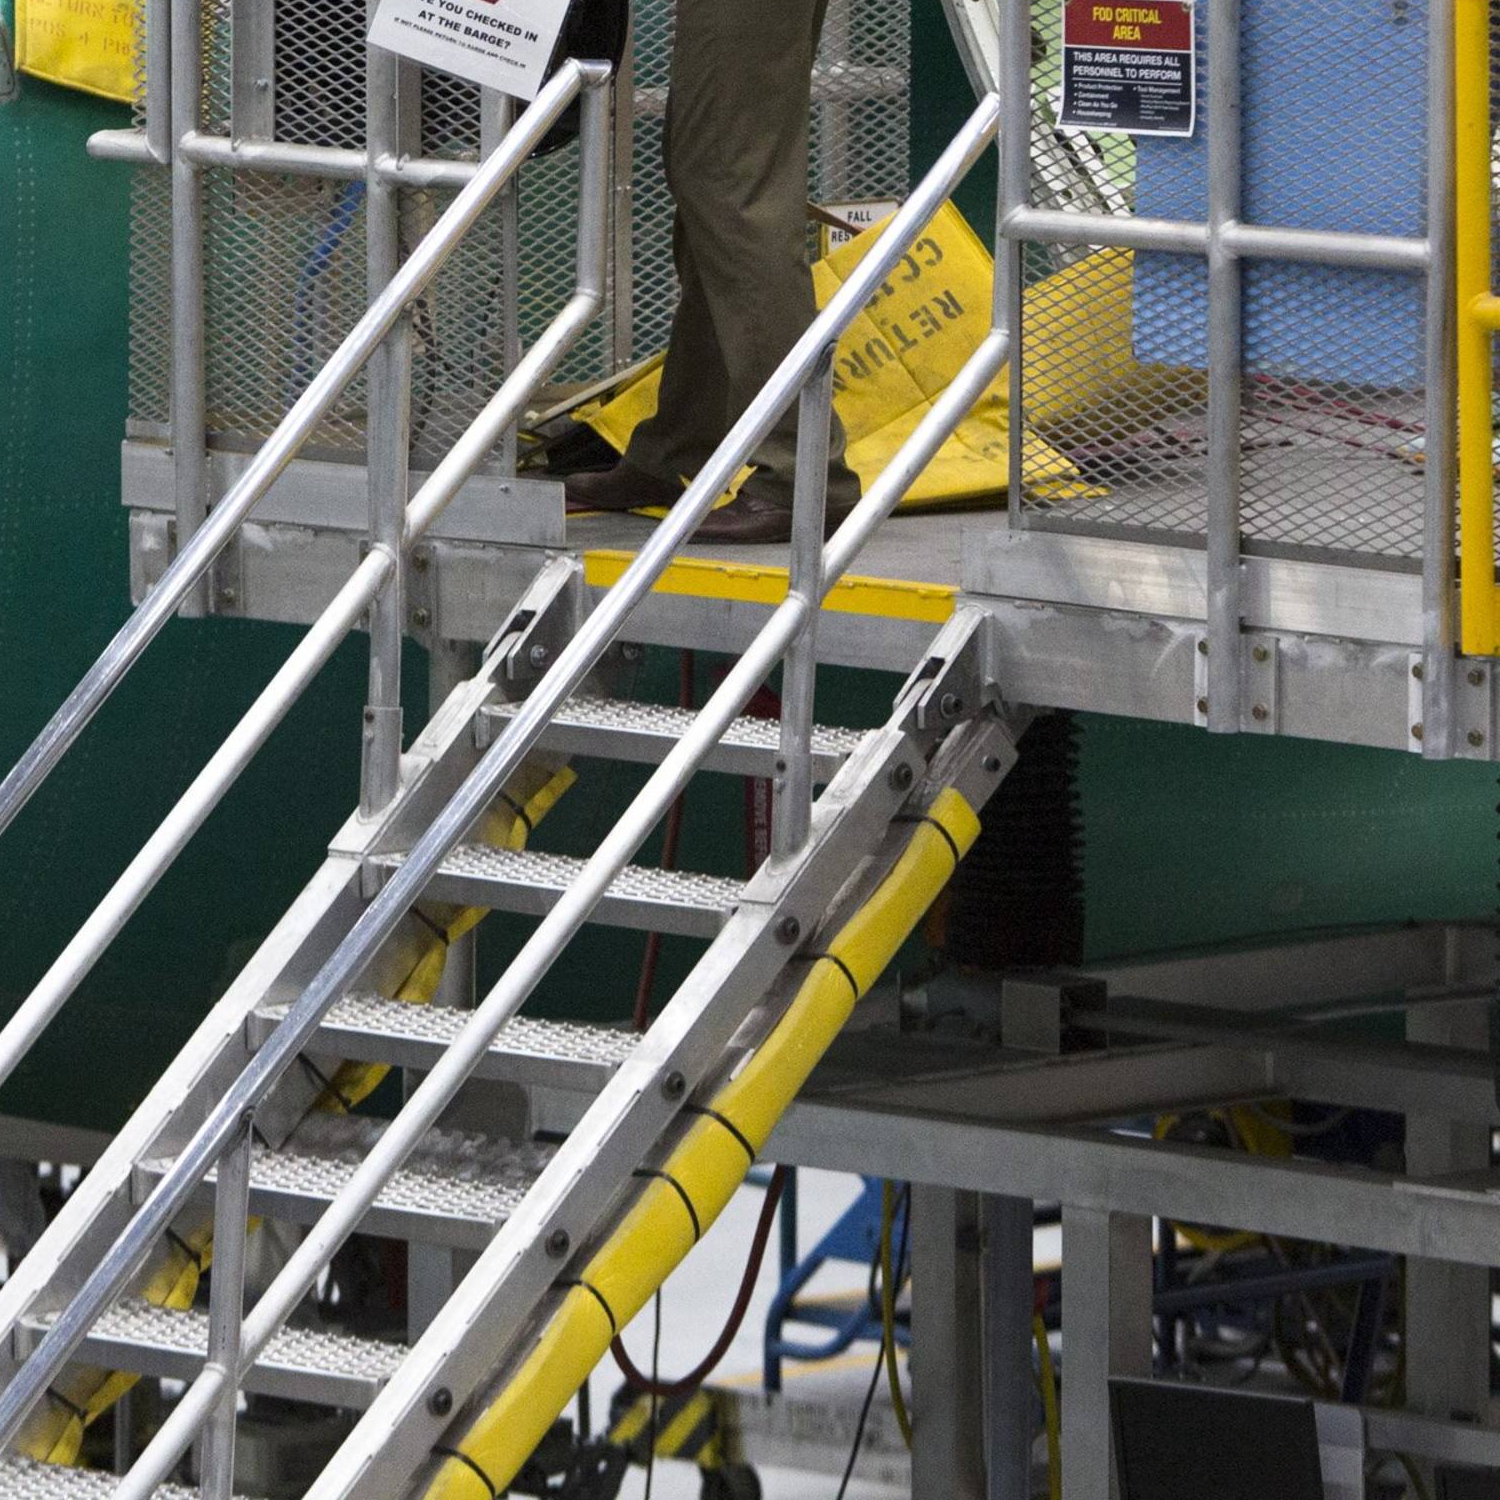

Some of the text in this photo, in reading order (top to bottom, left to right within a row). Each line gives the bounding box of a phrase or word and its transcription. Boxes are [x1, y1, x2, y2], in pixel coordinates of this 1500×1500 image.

[1093, 6, 1162, 24] FOD CRITICAL
[413, 23, 434, 35] PLEASE
[417, 9, 512, 50] AT THE BARGE?
[465, 8, 522, 36] CHECKED
[524, 30, 539, 43] IN
[1112, 25, 1141, 41] AREA
[1073, 51, 1181, 67] THIS AREA REQUIRES ALL
[1073, 65, 1182, 80] PERSONNEL TO PERFORM
[847, 211, 872, 222] FALL
[832, 230, 850, 242] RES
